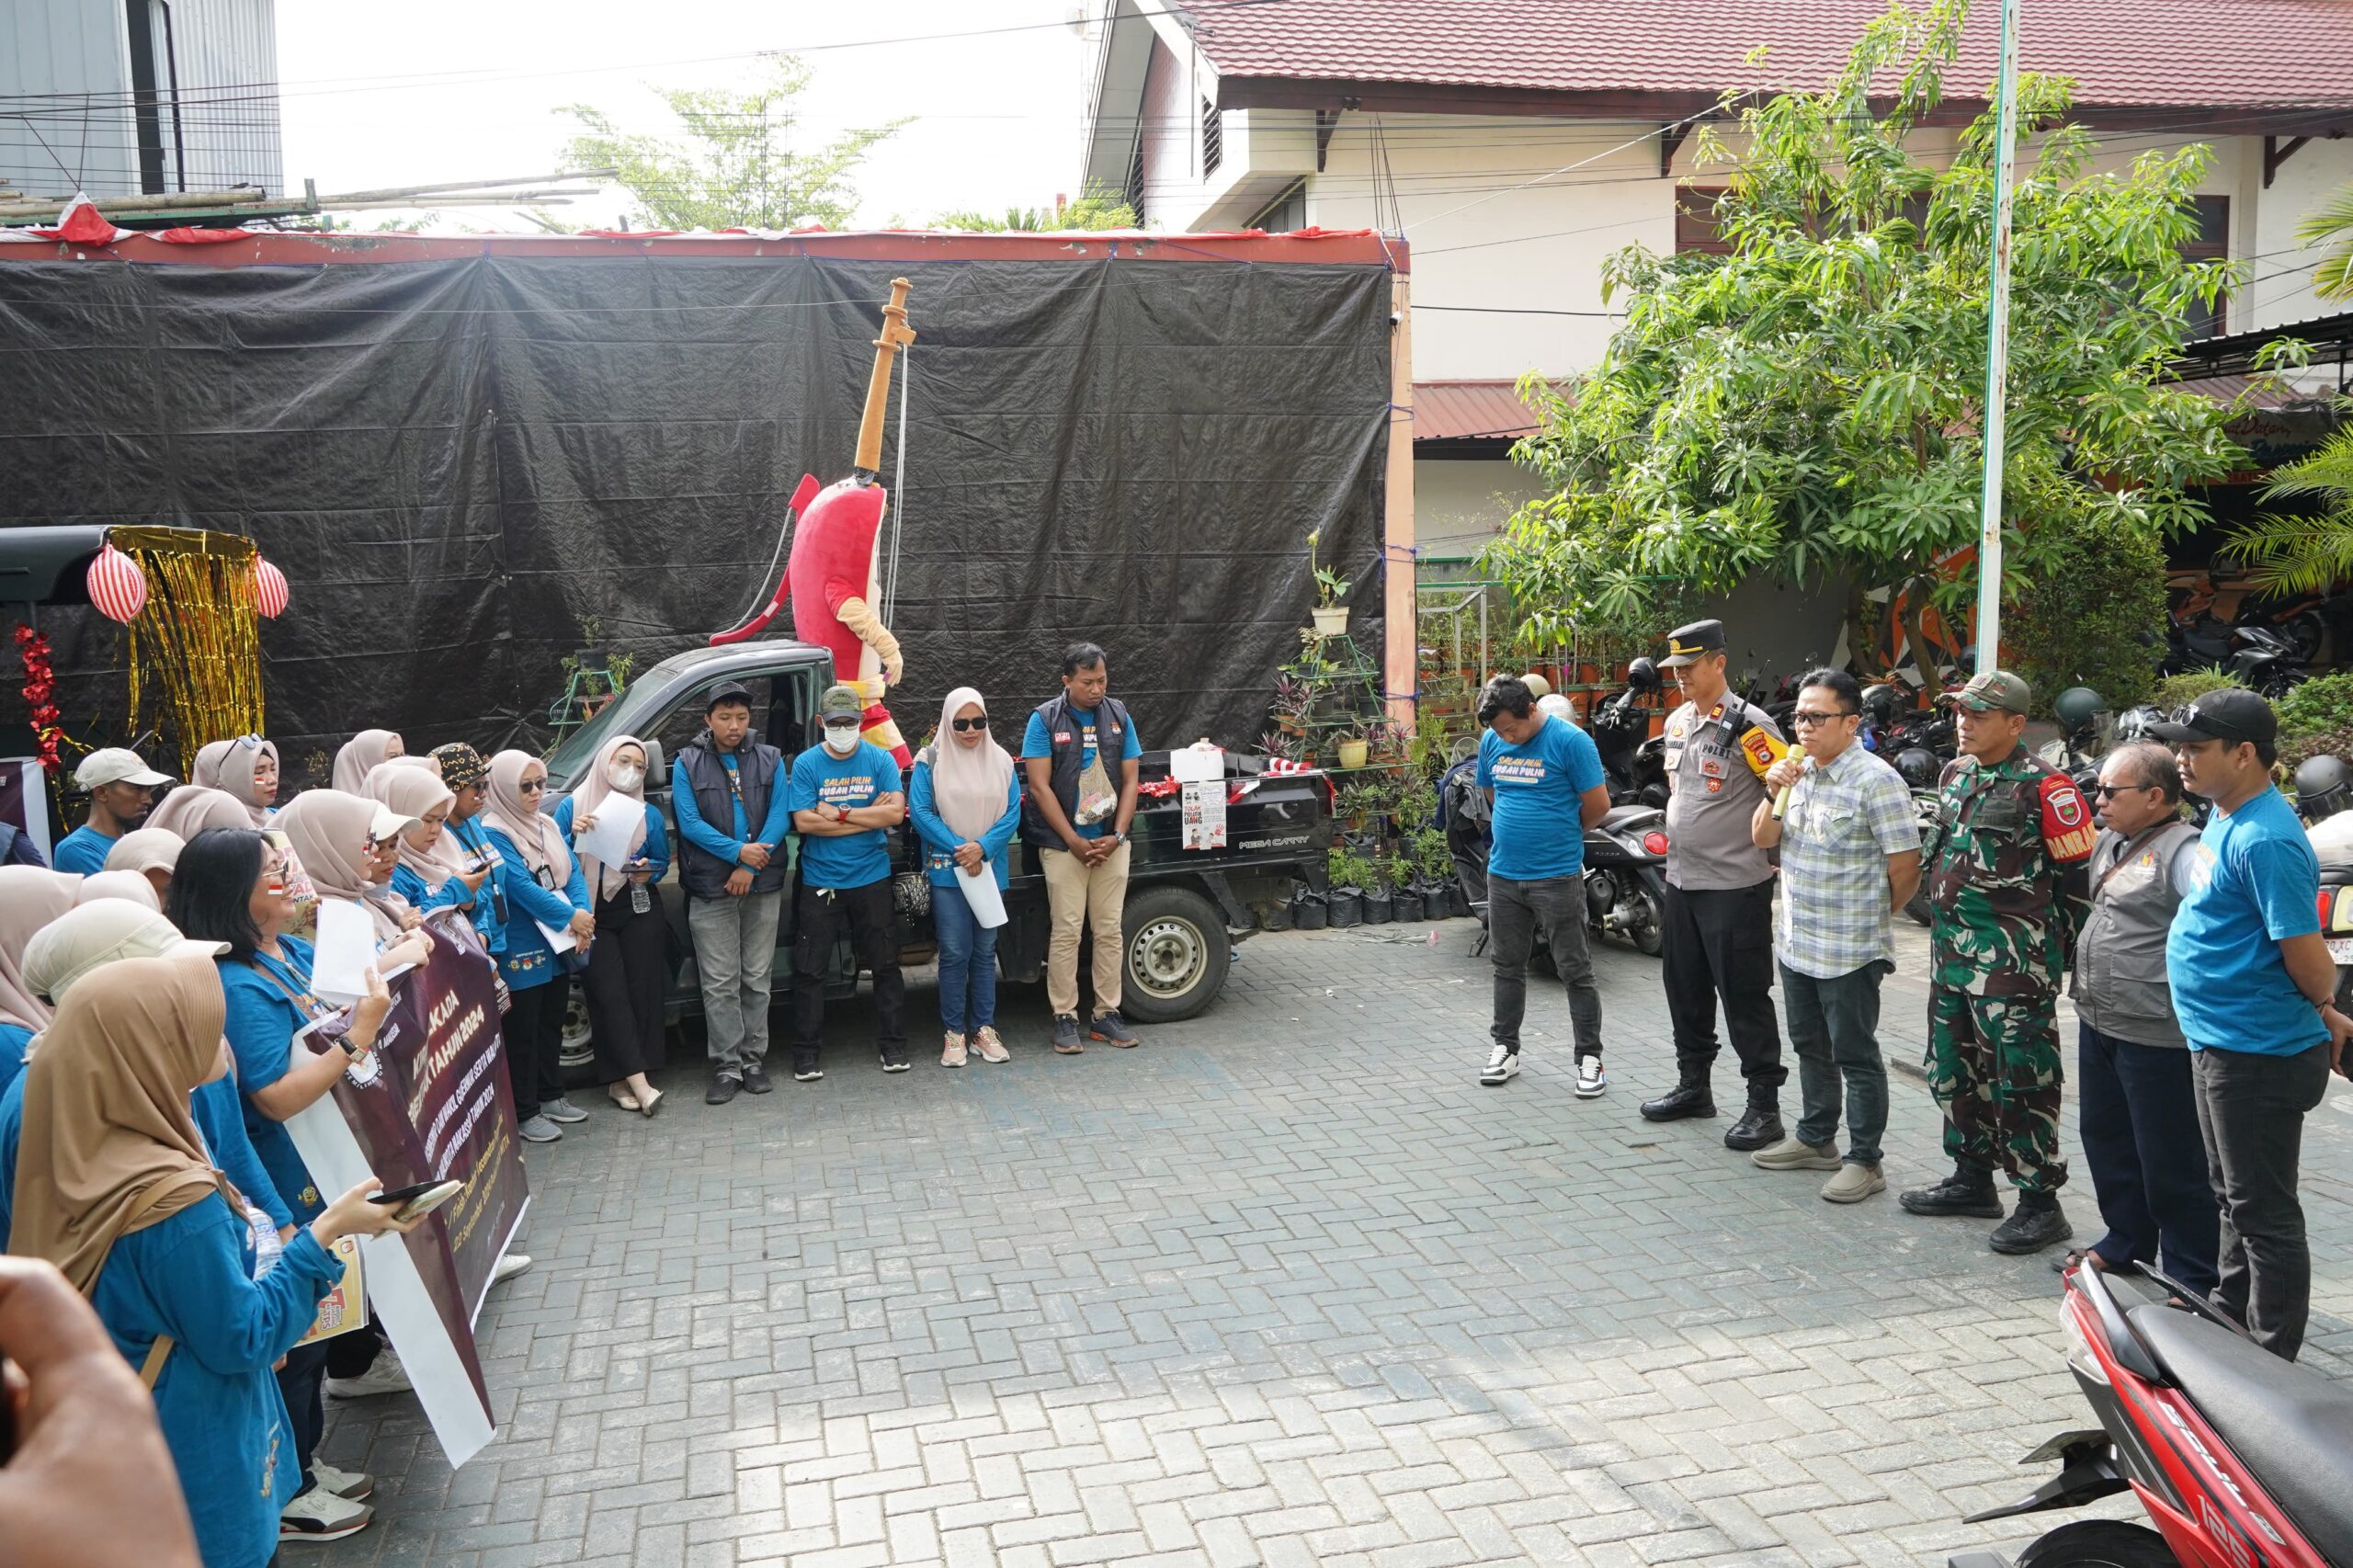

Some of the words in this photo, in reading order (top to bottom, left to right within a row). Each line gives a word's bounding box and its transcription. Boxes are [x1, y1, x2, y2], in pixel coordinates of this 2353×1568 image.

[824, 778, 850, 787] SALAH
[850, 776, 871, 785] PILIH
[1238, 840, 1271, 849] MEGA
[1271, 835, 1310, 847] CARRY
[2045, 820, 2097, 860] DANRA
[428, 1028, 463, 1078] TAHUN
[460, 1005, 485, 1043] 2024
